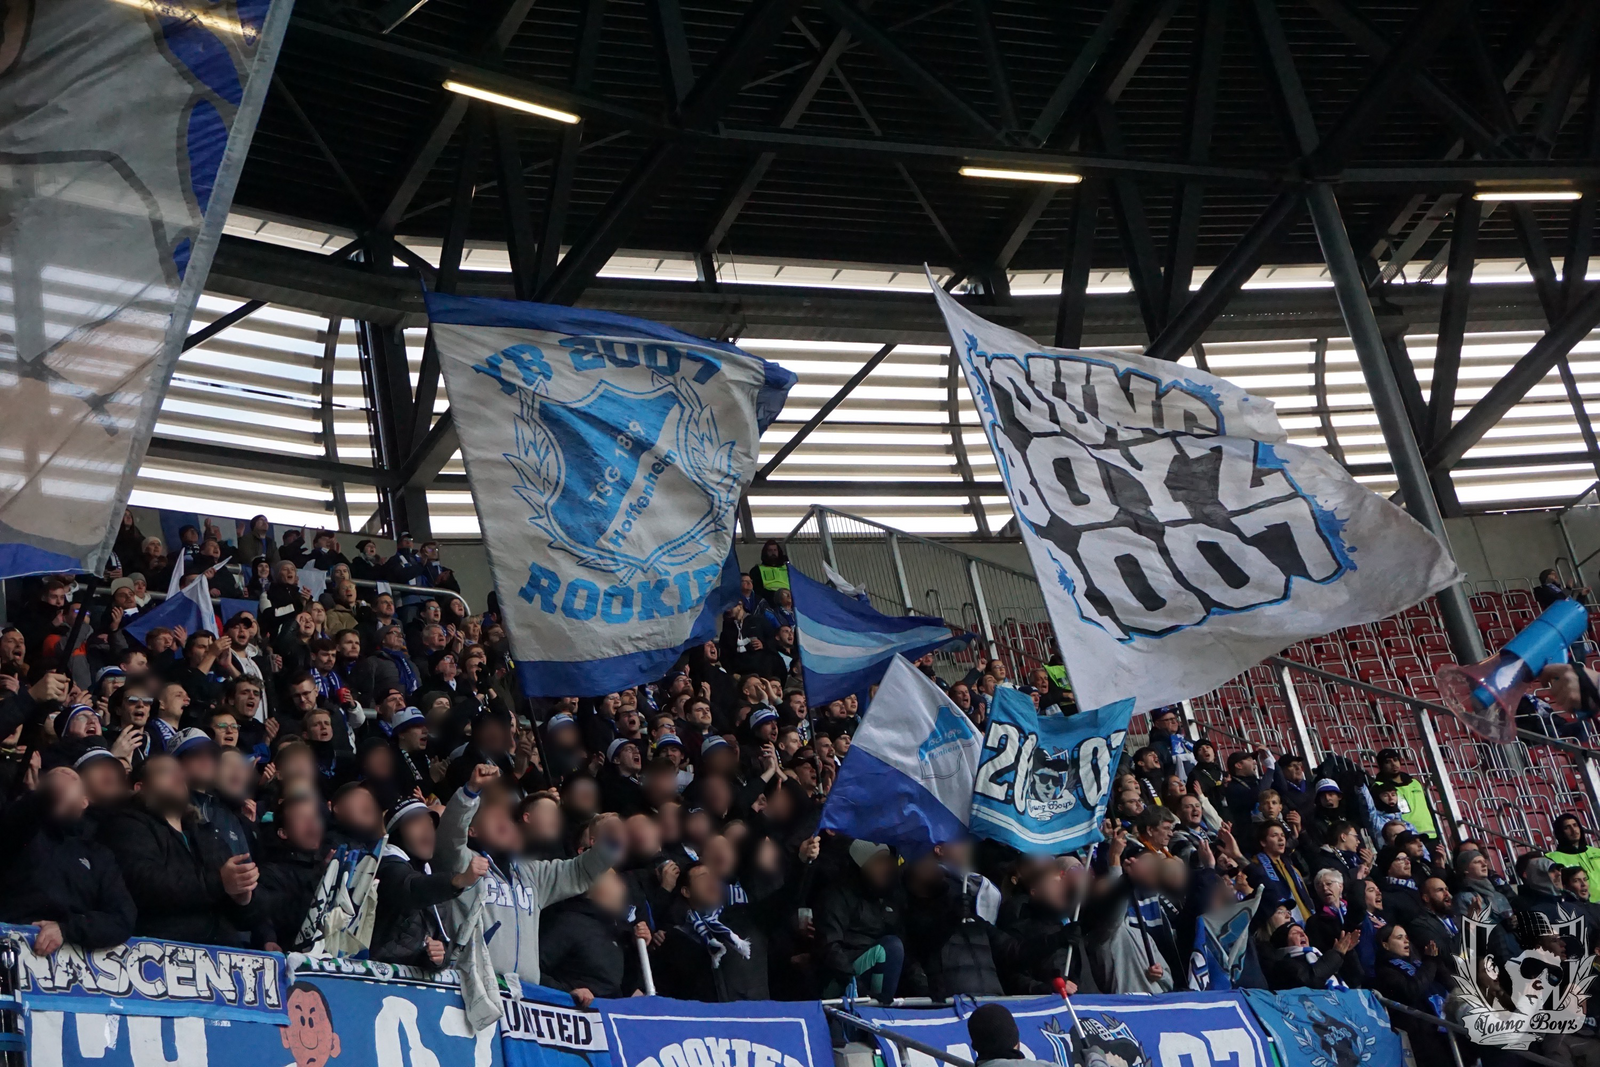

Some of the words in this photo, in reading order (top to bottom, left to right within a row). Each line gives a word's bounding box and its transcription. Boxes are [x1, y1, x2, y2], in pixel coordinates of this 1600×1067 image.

[472, 343, 554, 396] YB
[558, 336, 723, 386] 2007
[588, 465, 622, 506] TSG
[615, 421, 646, 459] 189
[608, 448, 679, 549] Hoffenheim
[17, 932, 281, 1009] NASCENTI
[502, 1000, 593, 1046] UNITED
